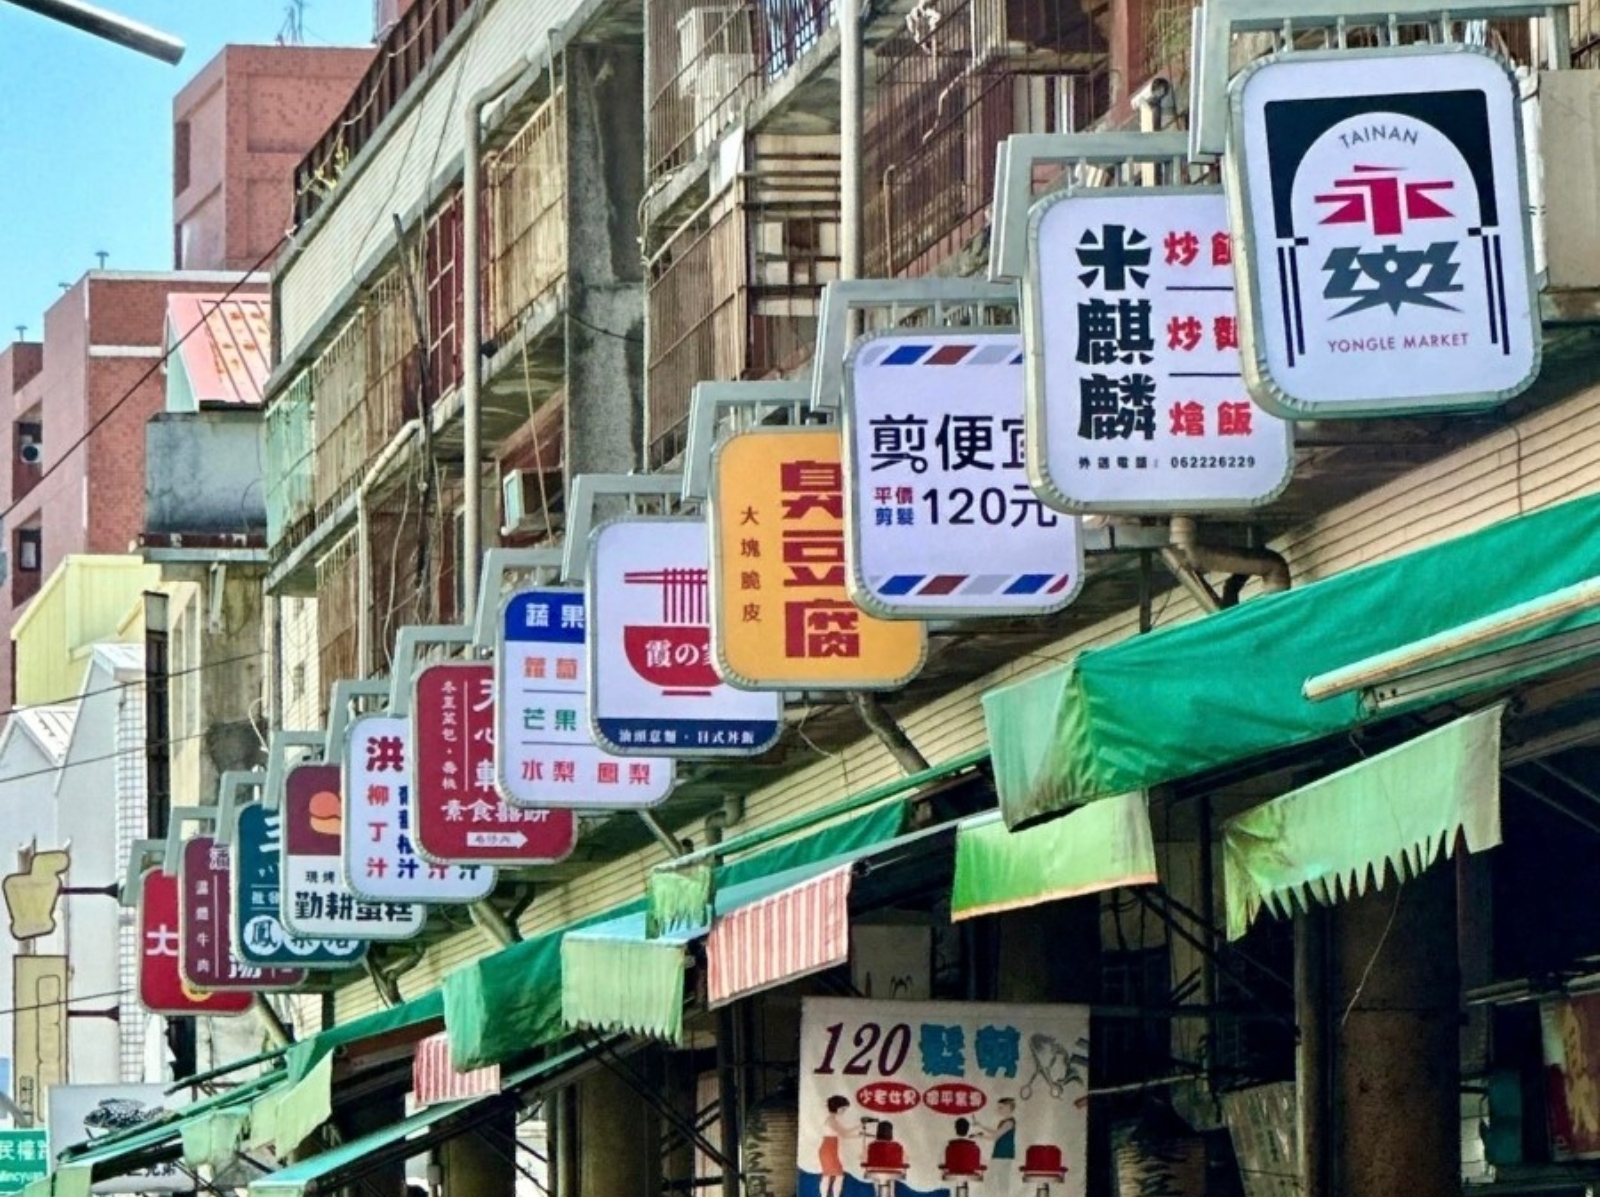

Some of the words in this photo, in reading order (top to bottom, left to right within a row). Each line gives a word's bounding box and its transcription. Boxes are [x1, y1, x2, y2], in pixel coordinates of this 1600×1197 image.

[1339, 124, 1418, 148] TAINAN
[1075, 224, 1156, 440] 米麒麟
[1328, 336, 1396, 353] YONGLE
[1403, 332, 1469, 349] MARKET
[1169, 401, 1252, 437] 燴飯
[1171, 456, 1255, 468] 062226229
[875, 487, 913, 504] 平價
[740, 506, 761, 623] 大塊脆皮
[781, 461, 860, 657] 臭豆腐
[523, 708, 576, 731] 芒果
[522, 760, 575, 782] 水梨
[597, 762, 650, 784] 鳳梨
[367, 784, 389, 878] 柳丁汁
[813, 1022, 911, 1077] 120
